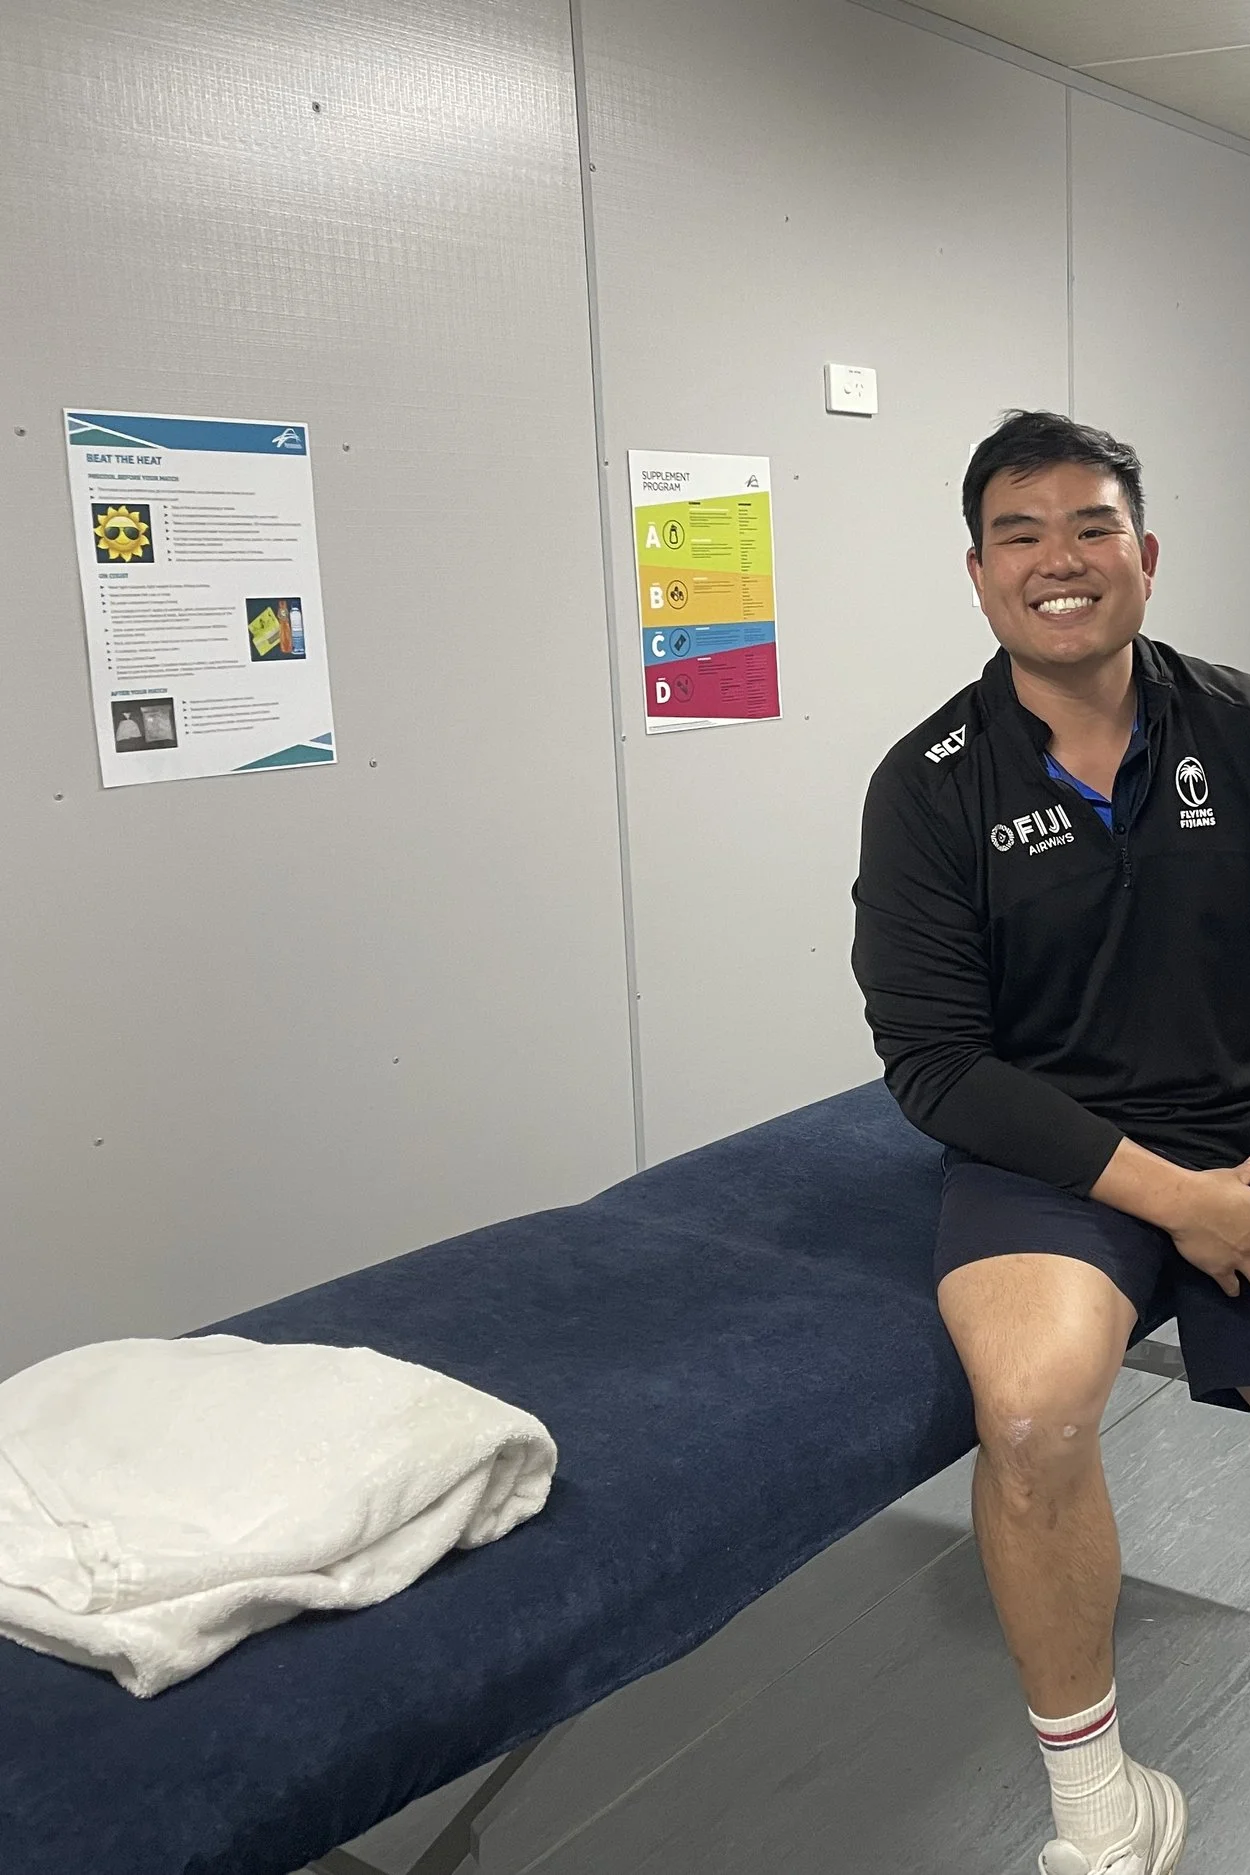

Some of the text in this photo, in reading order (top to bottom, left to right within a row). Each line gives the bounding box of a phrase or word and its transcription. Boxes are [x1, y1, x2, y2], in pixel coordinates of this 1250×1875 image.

[86, 453, 162, 466] BEAT THE HEAT
[641, 470, 690, 482] SUPPLEMENT
[642, 481, 682, 492] PROGRAM
[645, 525, 662, 549] A
[649, 586, 665, 609] B
[651, 634, 666, 658] C
[655, 681, 671, 704] D
[1012, 803, 1073, 844] FIJI
[1179, 807, 1214, 819] FLYING
[1179, 817, 1217, 829] FIJIANS
[1028, 832, 1075, 856] AIRWAYS
